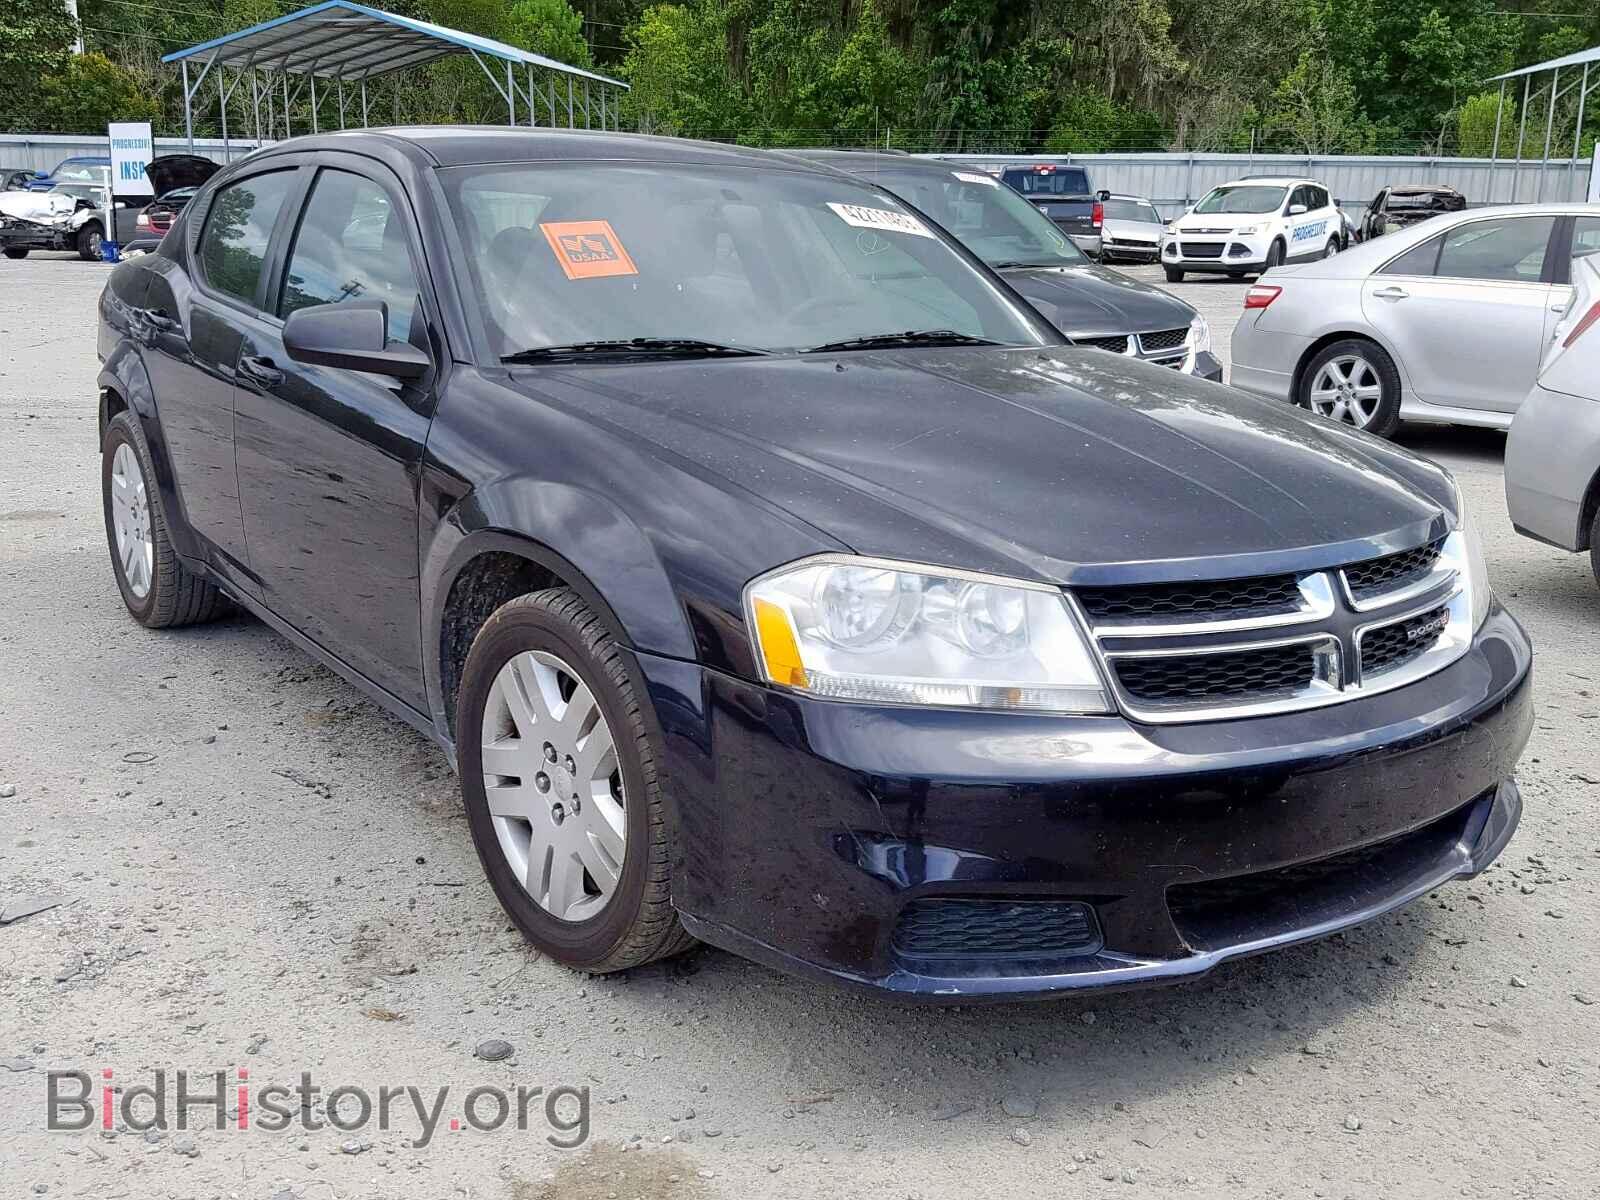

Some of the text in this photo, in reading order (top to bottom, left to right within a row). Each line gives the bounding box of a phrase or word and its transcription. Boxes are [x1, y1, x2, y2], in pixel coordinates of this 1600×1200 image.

[112, 138, 150, 150] PROGRESSIVE
[120, 161, 145, 180] INSP
[569, 251, 612, 262] USAA
